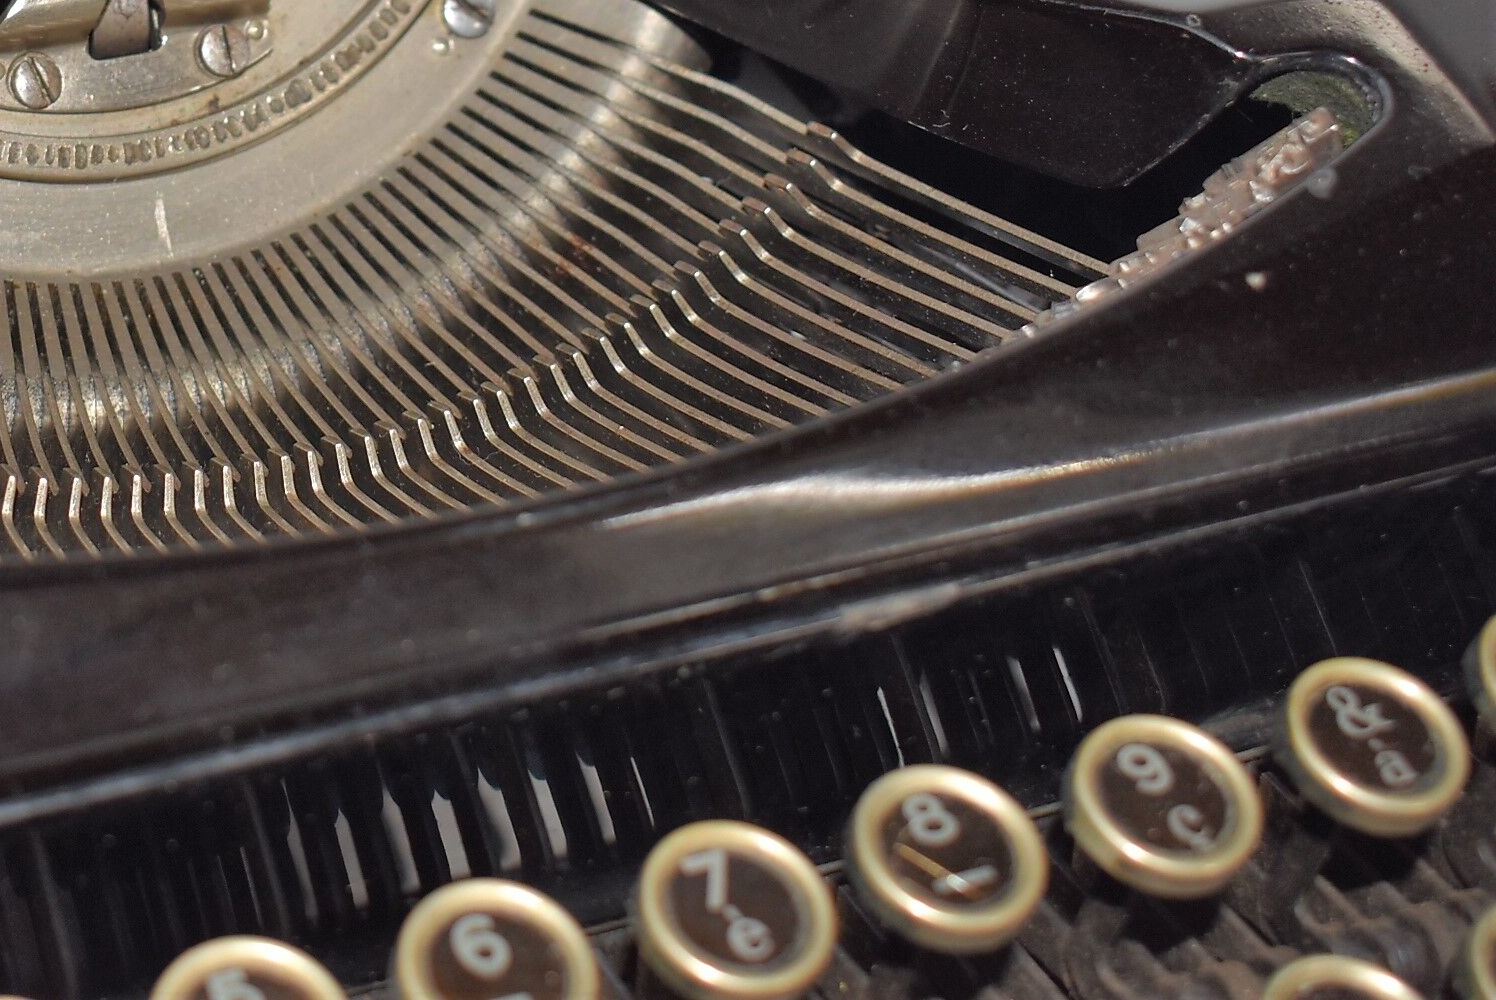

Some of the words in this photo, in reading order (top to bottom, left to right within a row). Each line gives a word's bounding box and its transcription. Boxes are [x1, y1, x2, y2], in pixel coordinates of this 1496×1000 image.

[1116, 743, 1174, 795] 9
[902, 792, 961, 846] 8
[678, 848, 727, 912] 7
[449, 912, 513, 980] 6
